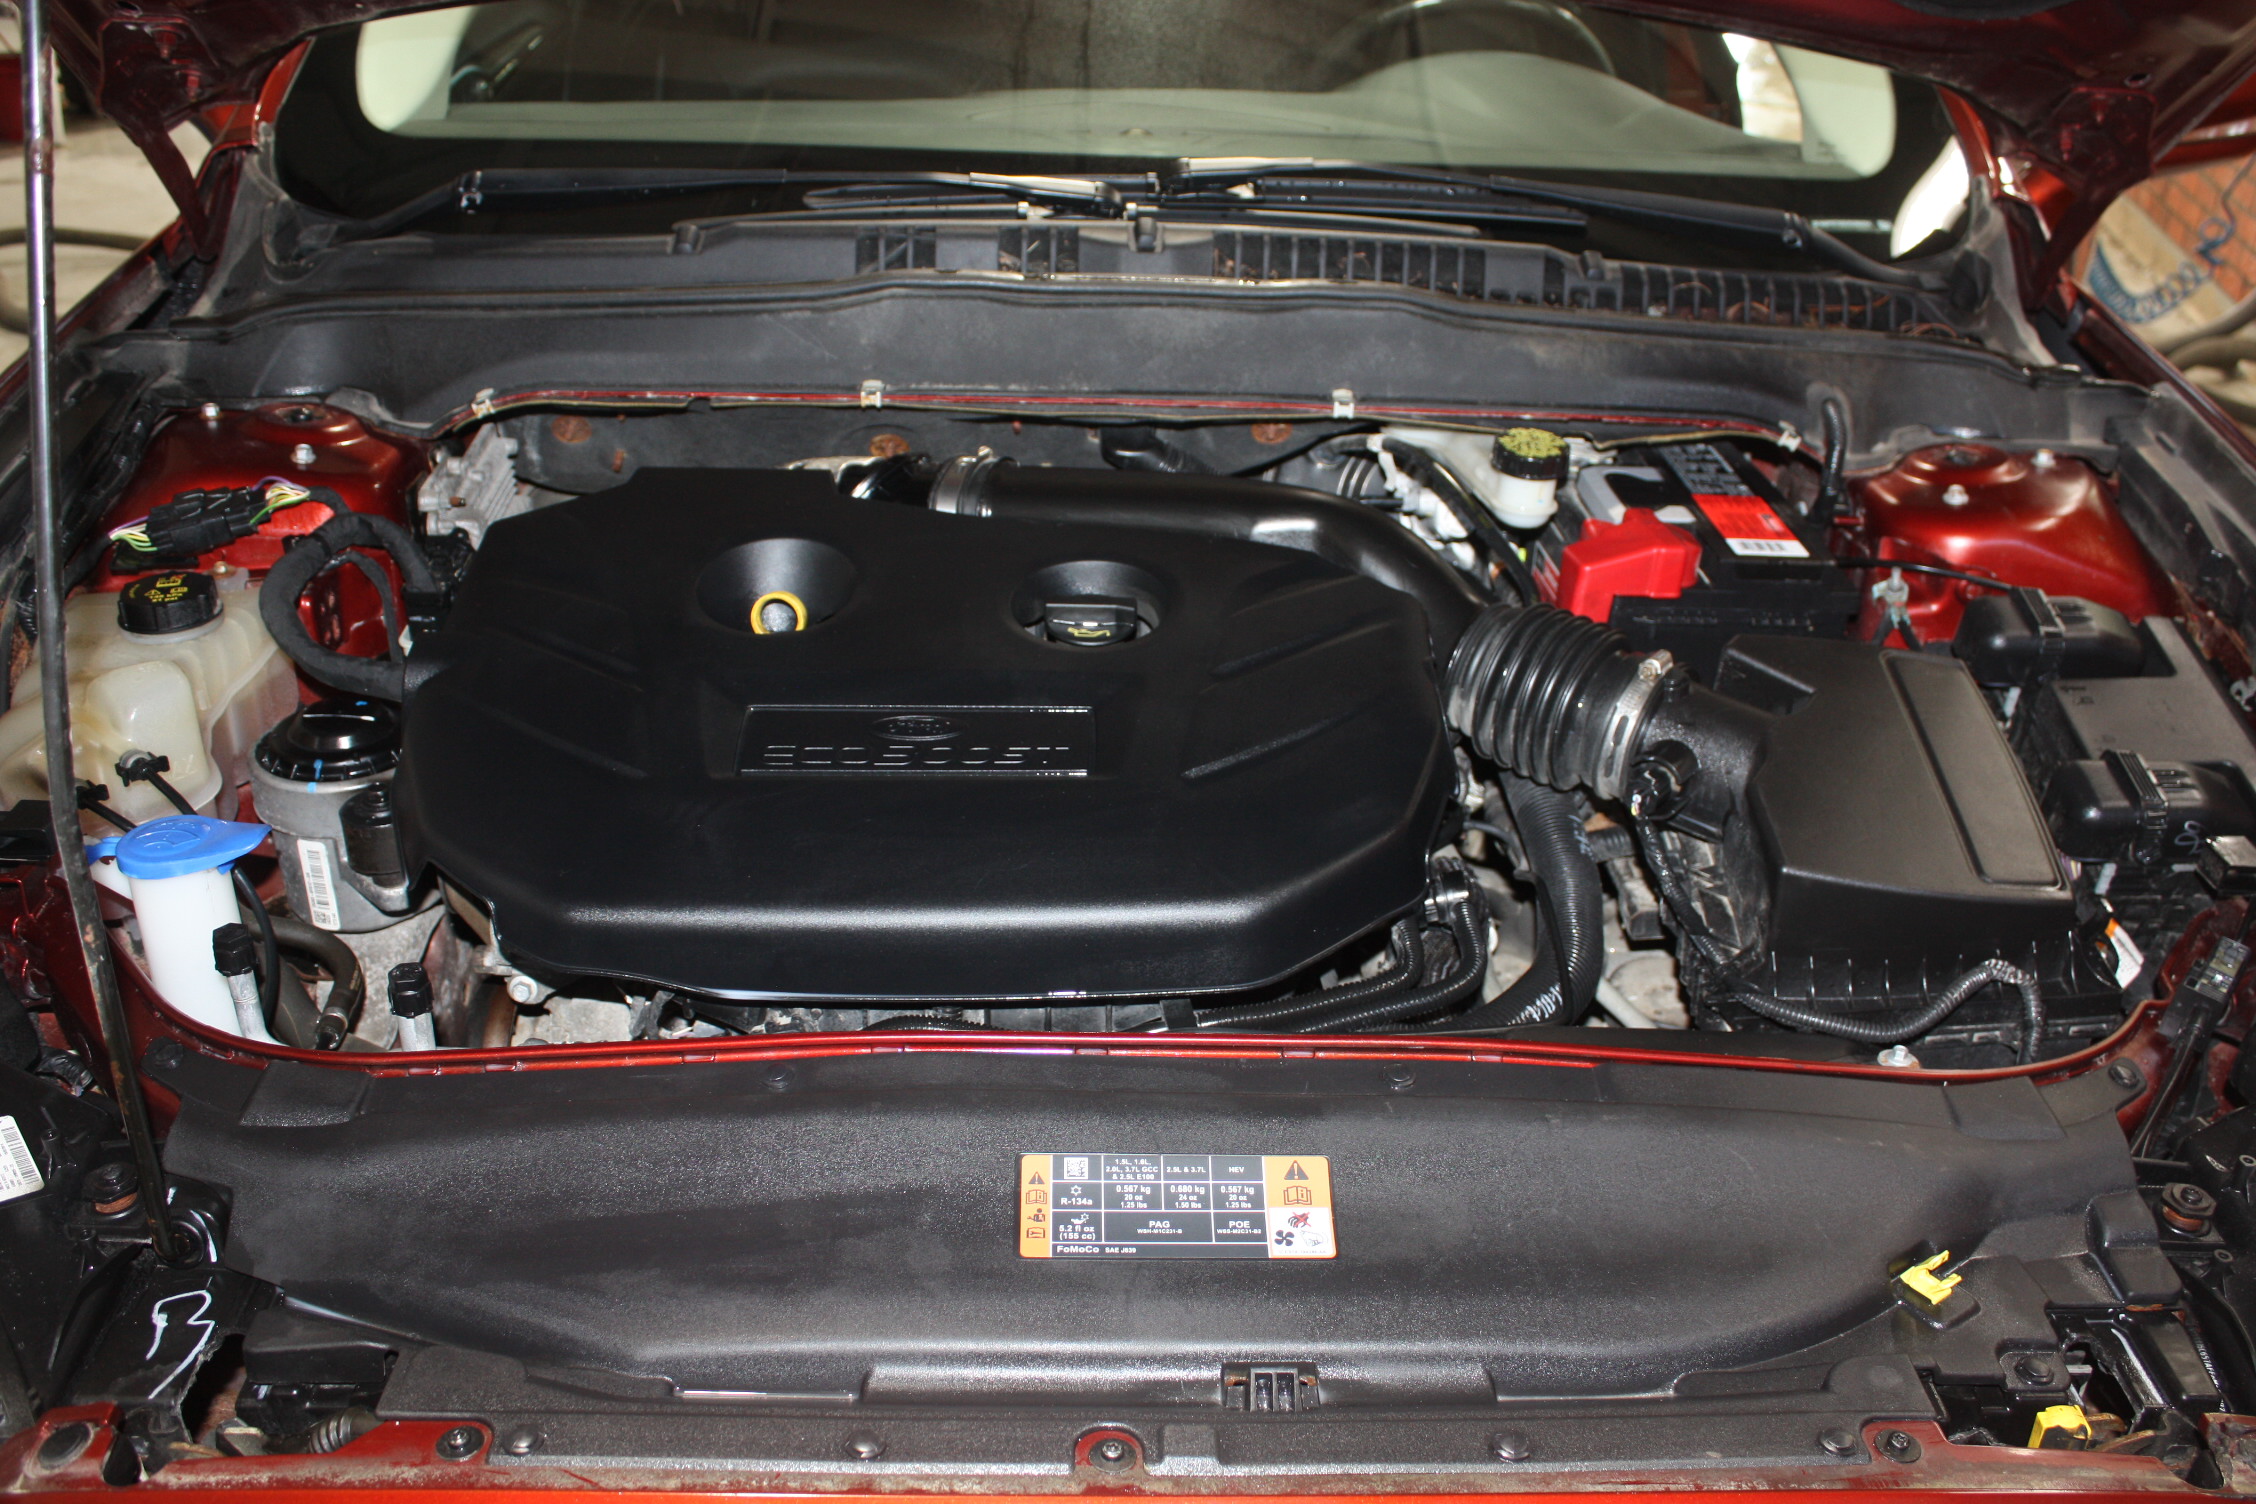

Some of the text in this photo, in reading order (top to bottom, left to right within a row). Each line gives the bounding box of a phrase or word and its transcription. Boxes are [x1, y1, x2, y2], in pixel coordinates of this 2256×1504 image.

[1140, 1185, 1151, 1194] kg
[1195, 1185, 1205, 1194] kg
[1244, 1186, 1254, 1194] kg
